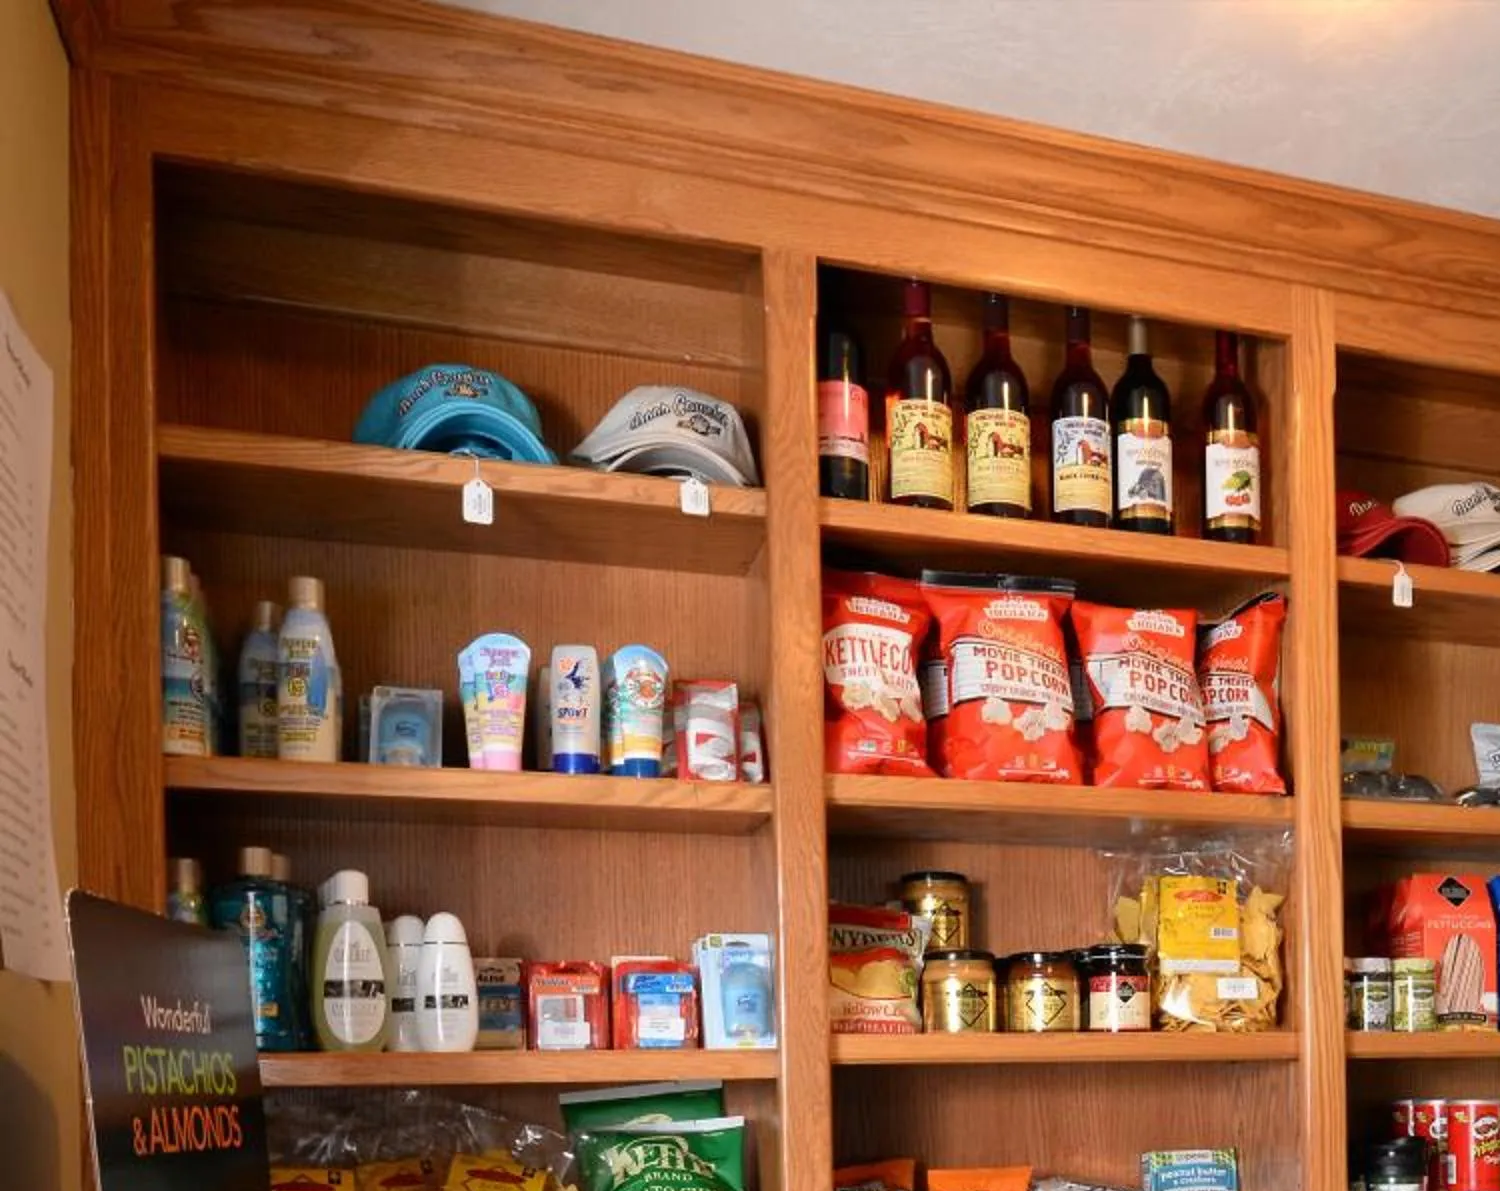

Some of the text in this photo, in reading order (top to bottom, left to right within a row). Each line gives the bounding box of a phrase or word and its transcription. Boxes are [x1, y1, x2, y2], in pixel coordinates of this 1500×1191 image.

[825, 637, 912, 675] KETTLECO
[973, 645, 1022, 663] MOVIE
[985, 660, 1070, 696] POPCORN
[141, 994, 212, 1035] Wonderful
[123, 1045, 238, 1095] PISTACHIOS
[132, 1103, 243, 1155] & ALMONDS
[644, 1171, 693, 1183] BRAND
